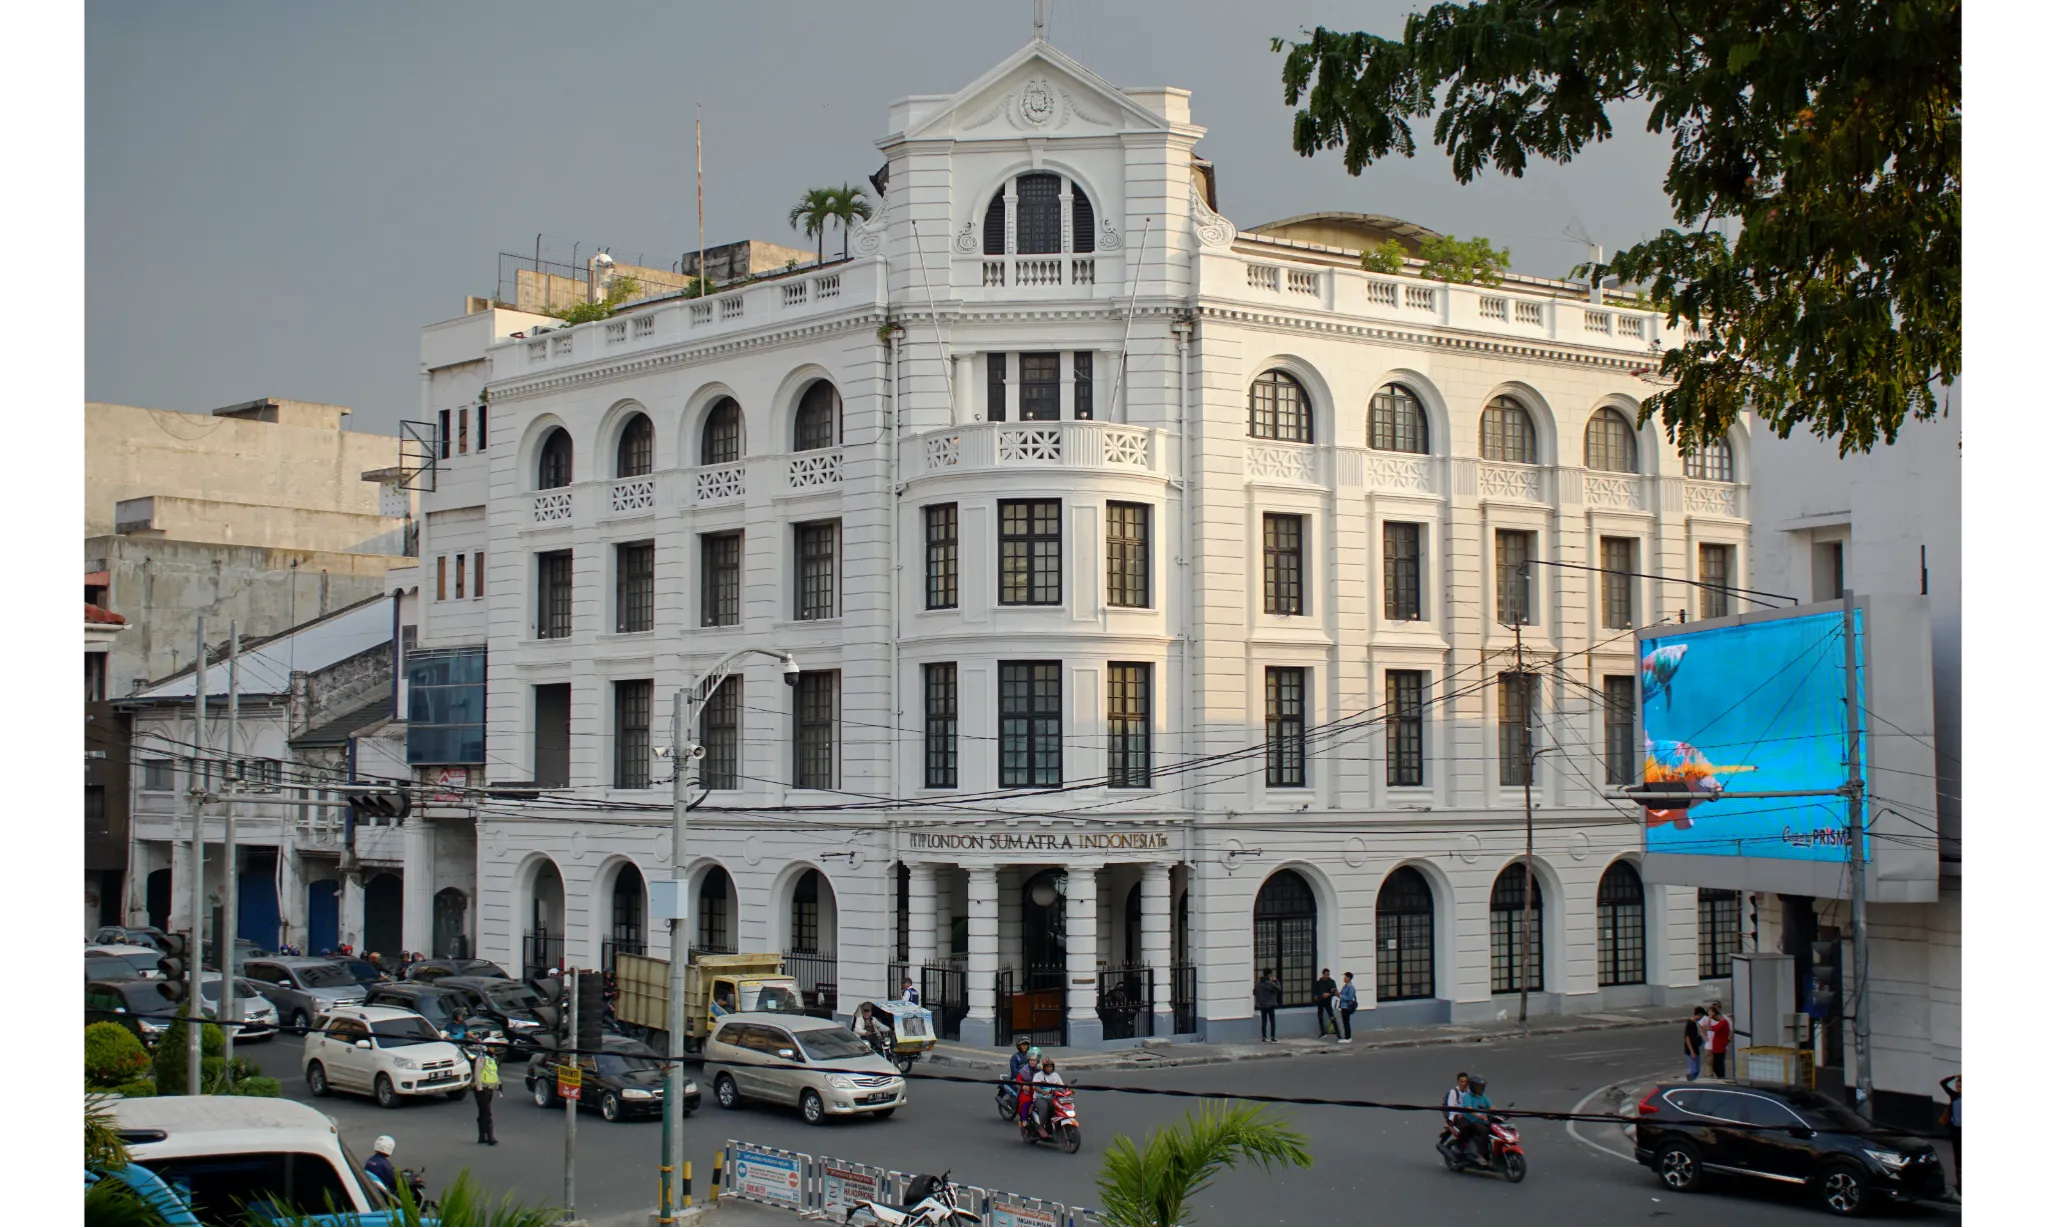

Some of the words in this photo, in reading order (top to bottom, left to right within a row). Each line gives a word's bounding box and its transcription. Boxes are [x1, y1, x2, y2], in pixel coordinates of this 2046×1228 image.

[927, 833, 984, 849] LONDON
[989, 834, 1073, 849] SUMATRA
[1079, 833, 1156, 849] INDONESIA
